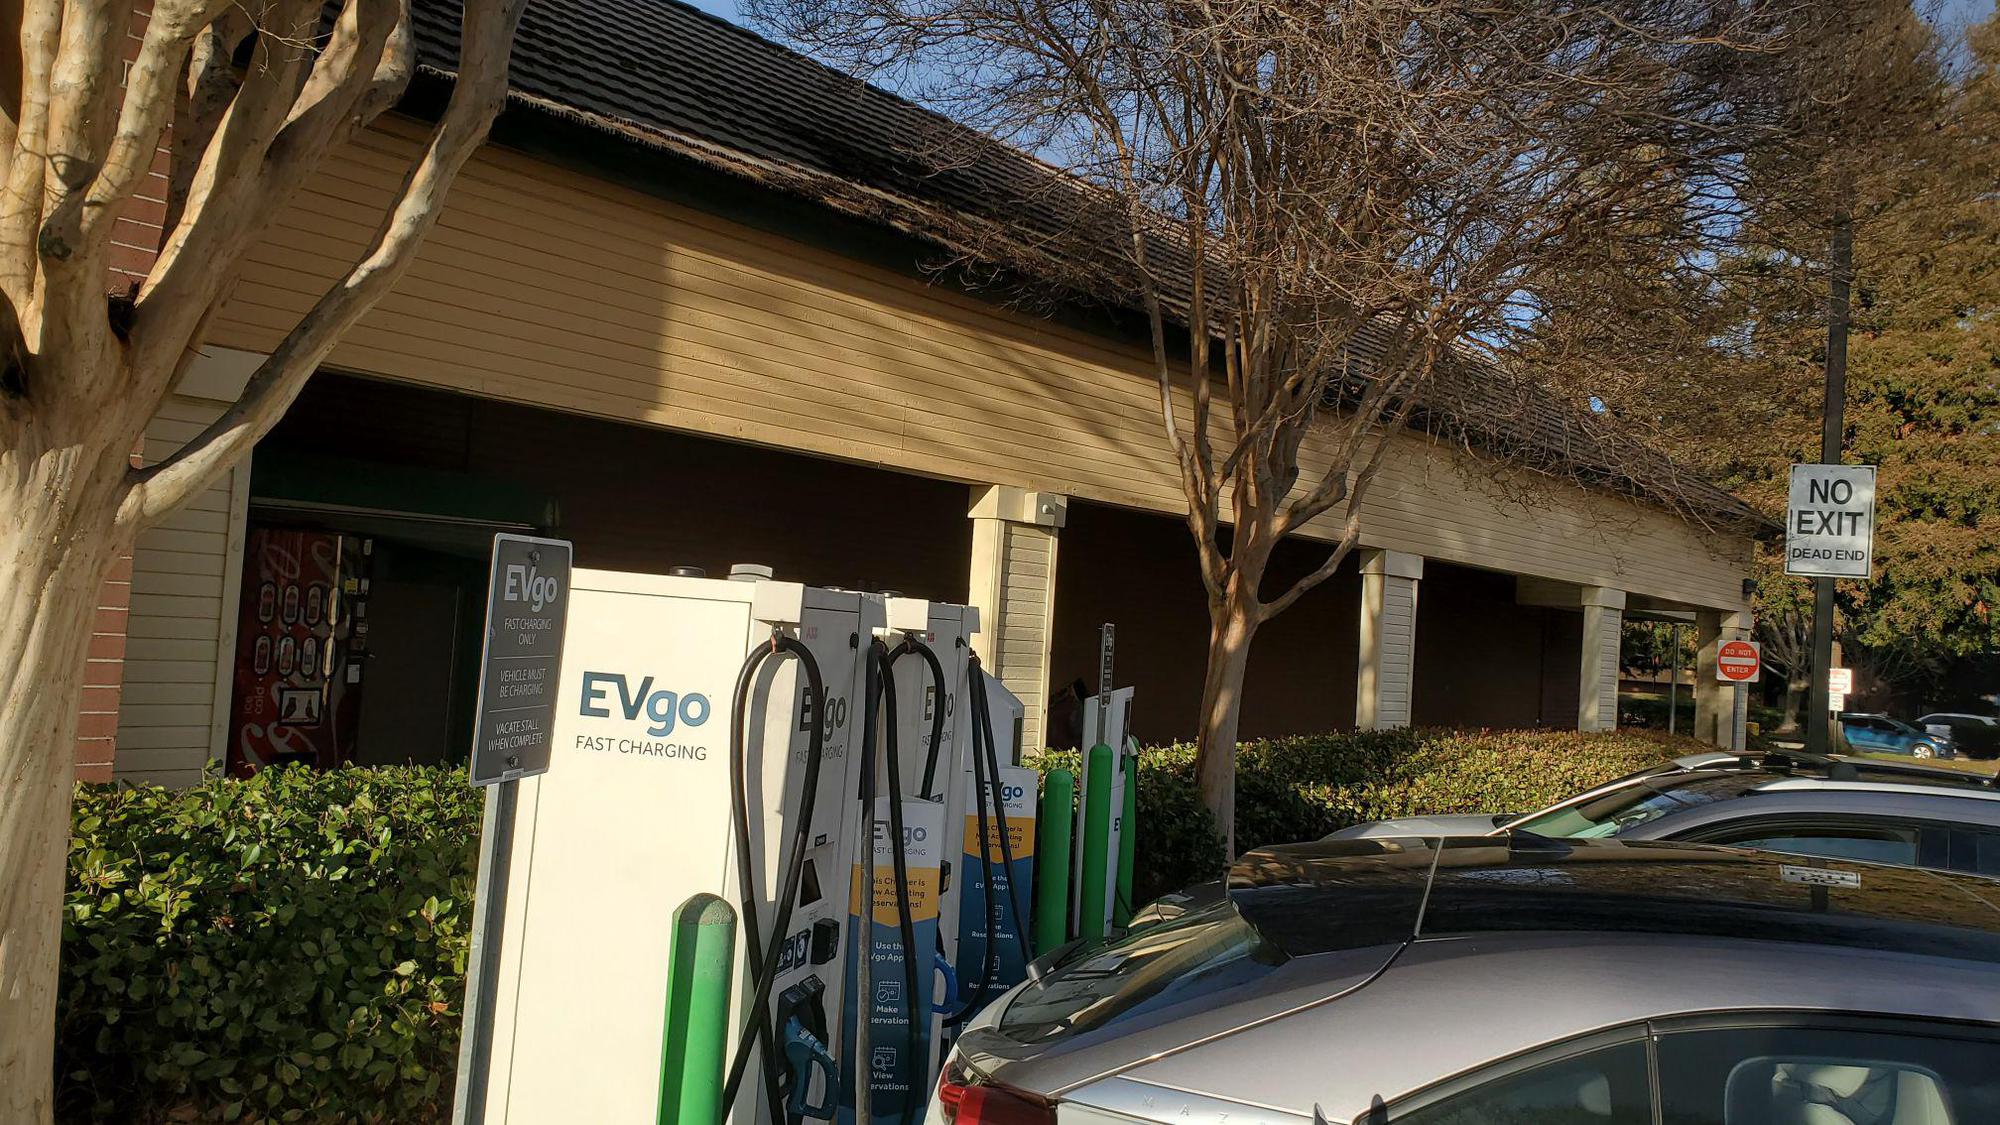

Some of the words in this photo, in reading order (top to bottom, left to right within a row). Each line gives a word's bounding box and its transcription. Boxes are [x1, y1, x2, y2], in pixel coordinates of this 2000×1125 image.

[1809, 478, 1853, 505] NO
[1796, 510, 1864, 537] EXIT
[1792, 547, 1832, 560] DEAD
[1835, 549, 1865, 561] END
[504, 564, 558, 613] EVgo
[504, 617, 520, 630] FAST
[520, 618, 552, 630] CHARGING
[518, 633, 537, 645] ONLY
[1738, 649, 1752, 657] NOT
[500, 669, 527, 682] VEHICLE
[527, 668, 546, 680] MUST
[499, 685, 508, 698] BE
[509, 682, 543, 697] CHARGING
[579, 671, 711, 737] EVgo
[925, 685, 954, 721] Eo
[799, 686, 847, 742] Ego
[495, 720, 521, 735] VACATE
[521, 719, 539, 732] STALL
[488, 737, 509, 752] WHEN
[509, 732, 543, 748] COMPLETE
[575, 735, 615, 752] FAST
[618, 739, 707, 761] CHARGING
[984, 781, 1024, 801] Ego
[873, 846, 885, 854] AST
[875, 941, 892, 950] Use
[892, 941, 904, 950] th
[870, 952, 886, 962] Vgo
[886, 953, 904, 963] App
[876, 1005, 899, 1013] Make
[872, 1070, 894, 1079] View
